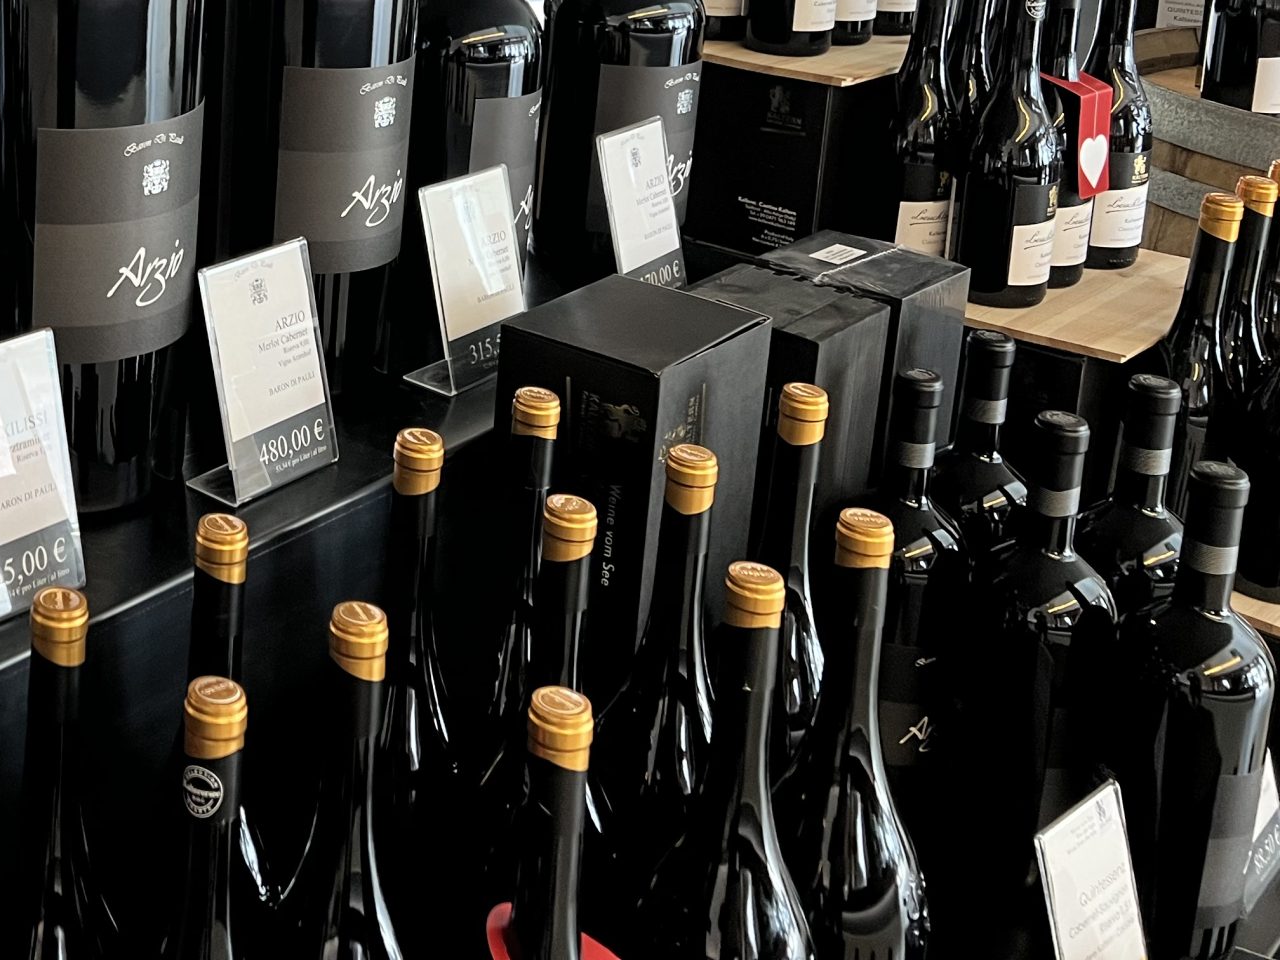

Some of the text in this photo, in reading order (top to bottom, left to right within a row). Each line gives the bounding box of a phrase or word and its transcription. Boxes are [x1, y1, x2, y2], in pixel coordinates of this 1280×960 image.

[673, 260, 681, 278] €
[275, 310, 306, 333] ARZIO
[280, 328, 309, 346] Cabernet
[260, 418, 325, 465] 480,00 €
[24, 490, 33, 502] DI
[53, 537, 68, 563] €
[602, 530, 614, 558] vom
[600, 561, 615, 587] See
